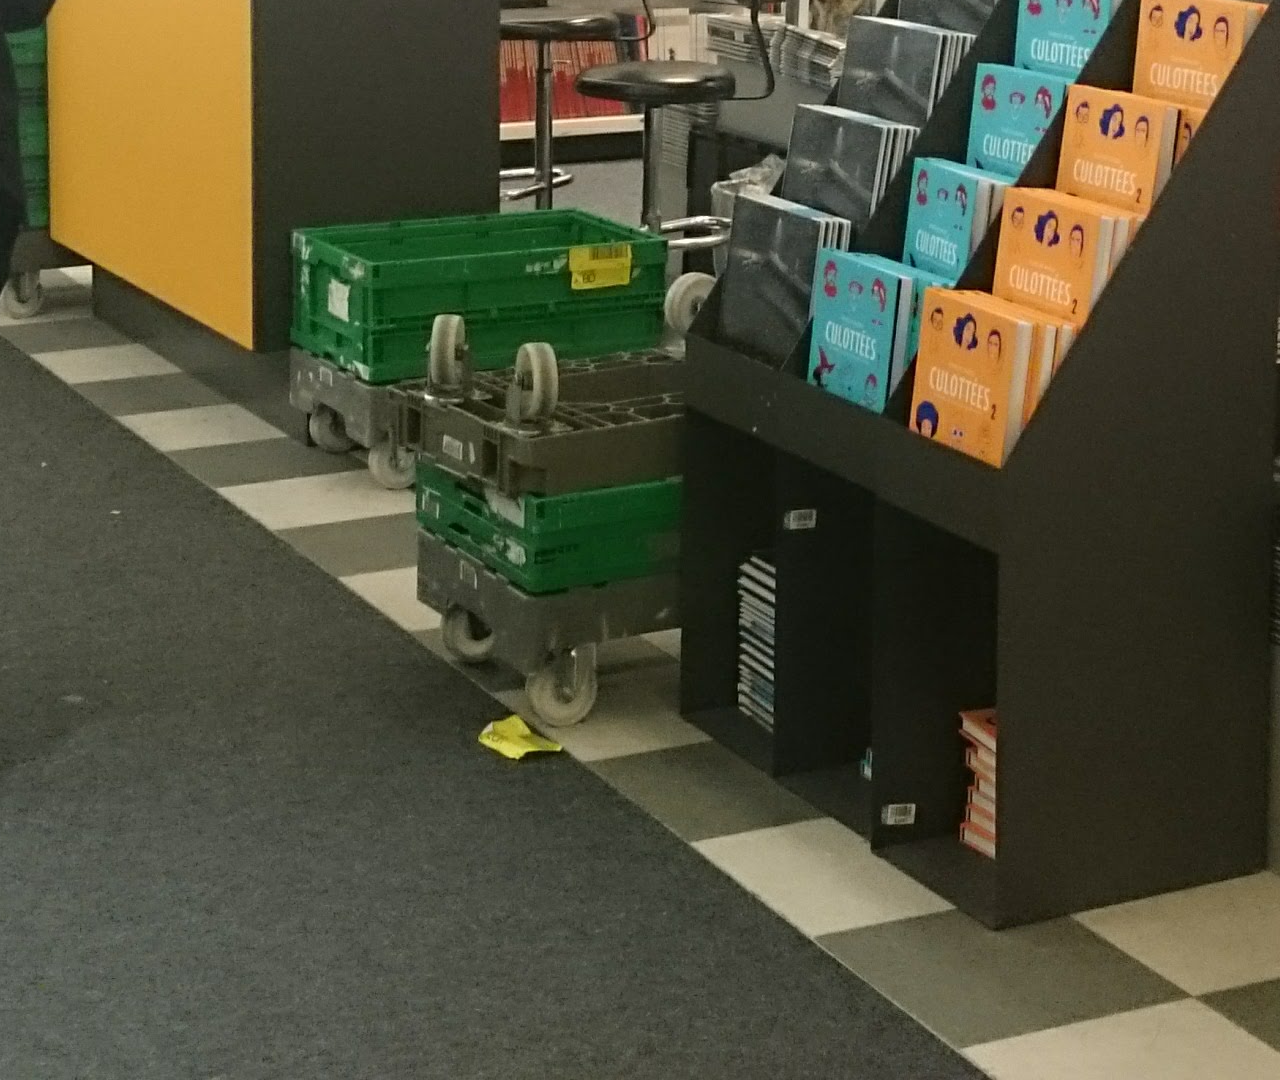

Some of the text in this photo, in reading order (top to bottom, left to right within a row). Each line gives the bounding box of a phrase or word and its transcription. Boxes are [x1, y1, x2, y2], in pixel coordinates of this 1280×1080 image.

[983, 133, 1036, 165] CULOTTÉE
[1073, 158, 1142, 204] CULOTTÉES 2
[1009, 264, 1079, 315] CULOTTÉES 2
[825, 321, 877, 361] CULOTTÉES
[929, 366, 998, 421] CULOTTÉES 2
